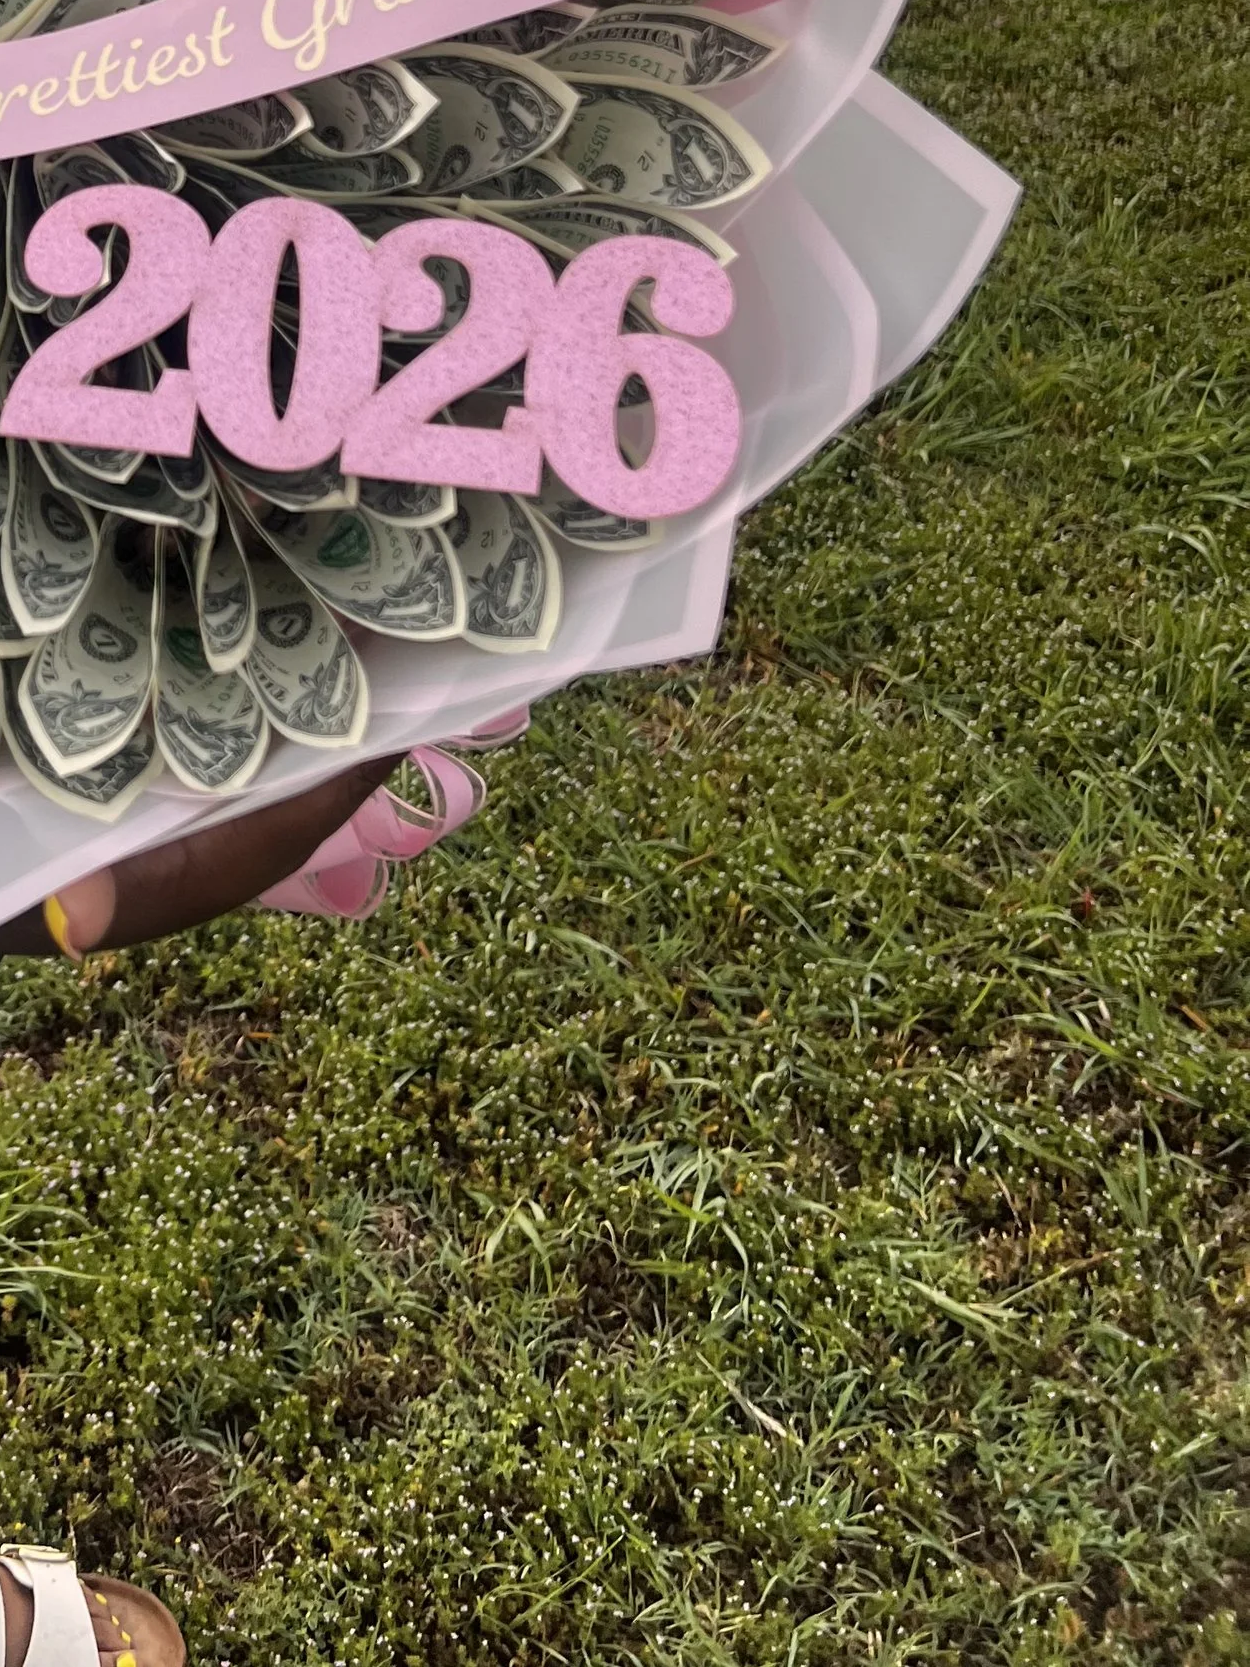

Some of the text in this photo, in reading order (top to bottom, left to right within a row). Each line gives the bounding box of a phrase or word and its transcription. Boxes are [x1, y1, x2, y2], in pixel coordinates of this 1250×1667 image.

[568, 49, 664, 75] 03555621
[474, 121, 489, 142] 12
[507, 101, 538, 133] 1
[637, 150, 655, 172] 12
[684, 137, 715, 184] 1
[0, 184, 740, 520] 2026
[481, 529, 494, 548] 12
[507, 556, 527, 607] 1
[380, 601, 431, 616] 1
[330, 652, 348, 705] 1
[170, 721, 216, 763] 1
